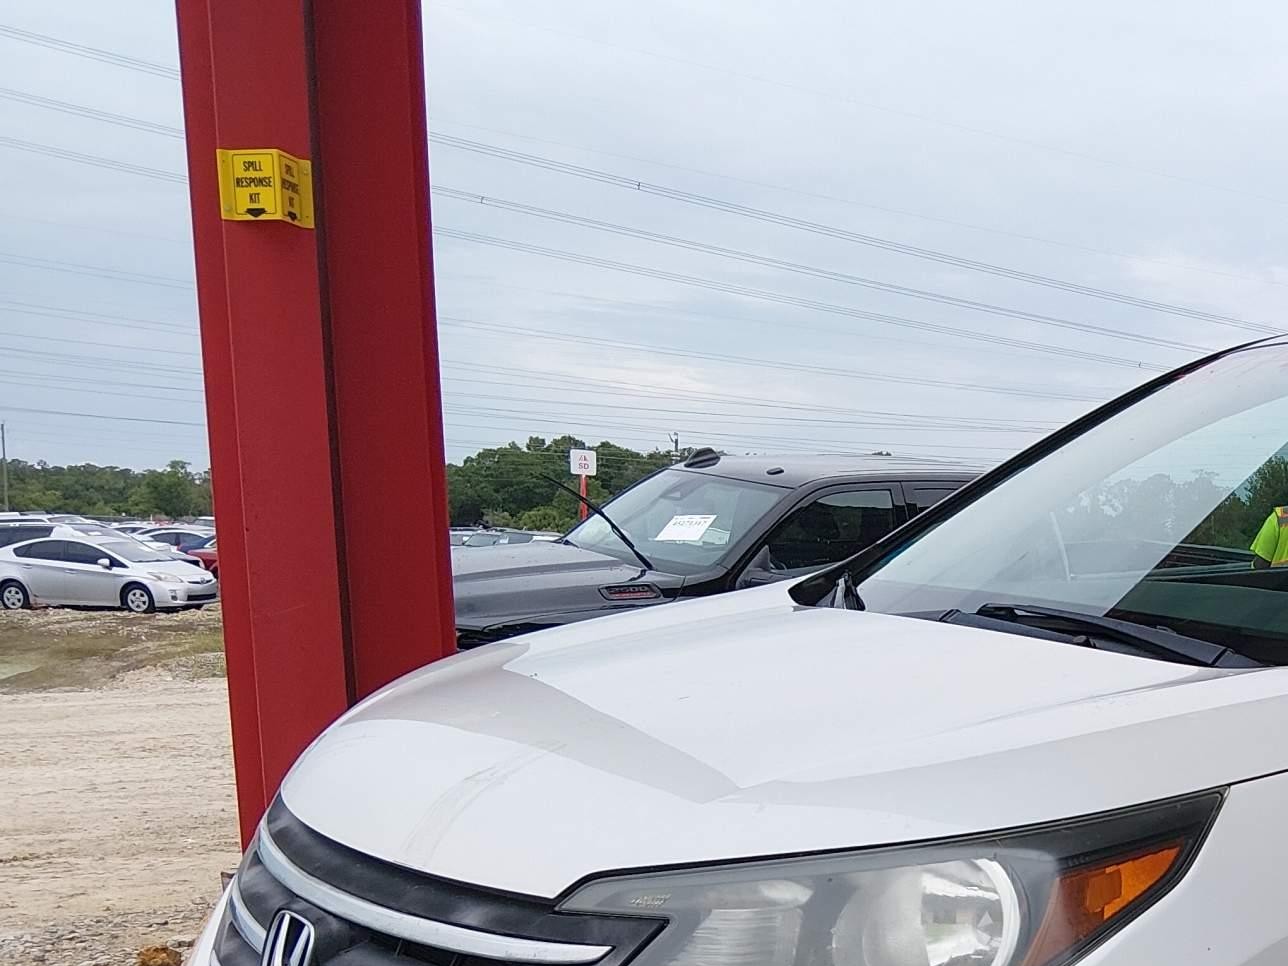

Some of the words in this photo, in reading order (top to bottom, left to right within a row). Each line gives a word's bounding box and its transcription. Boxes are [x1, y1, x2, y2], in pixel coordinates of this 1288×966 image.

[243, 161, 263, 172] SPILL
[236, 176, 272, 188] RESPONSE
[249, 193, 260, 204] KIT
